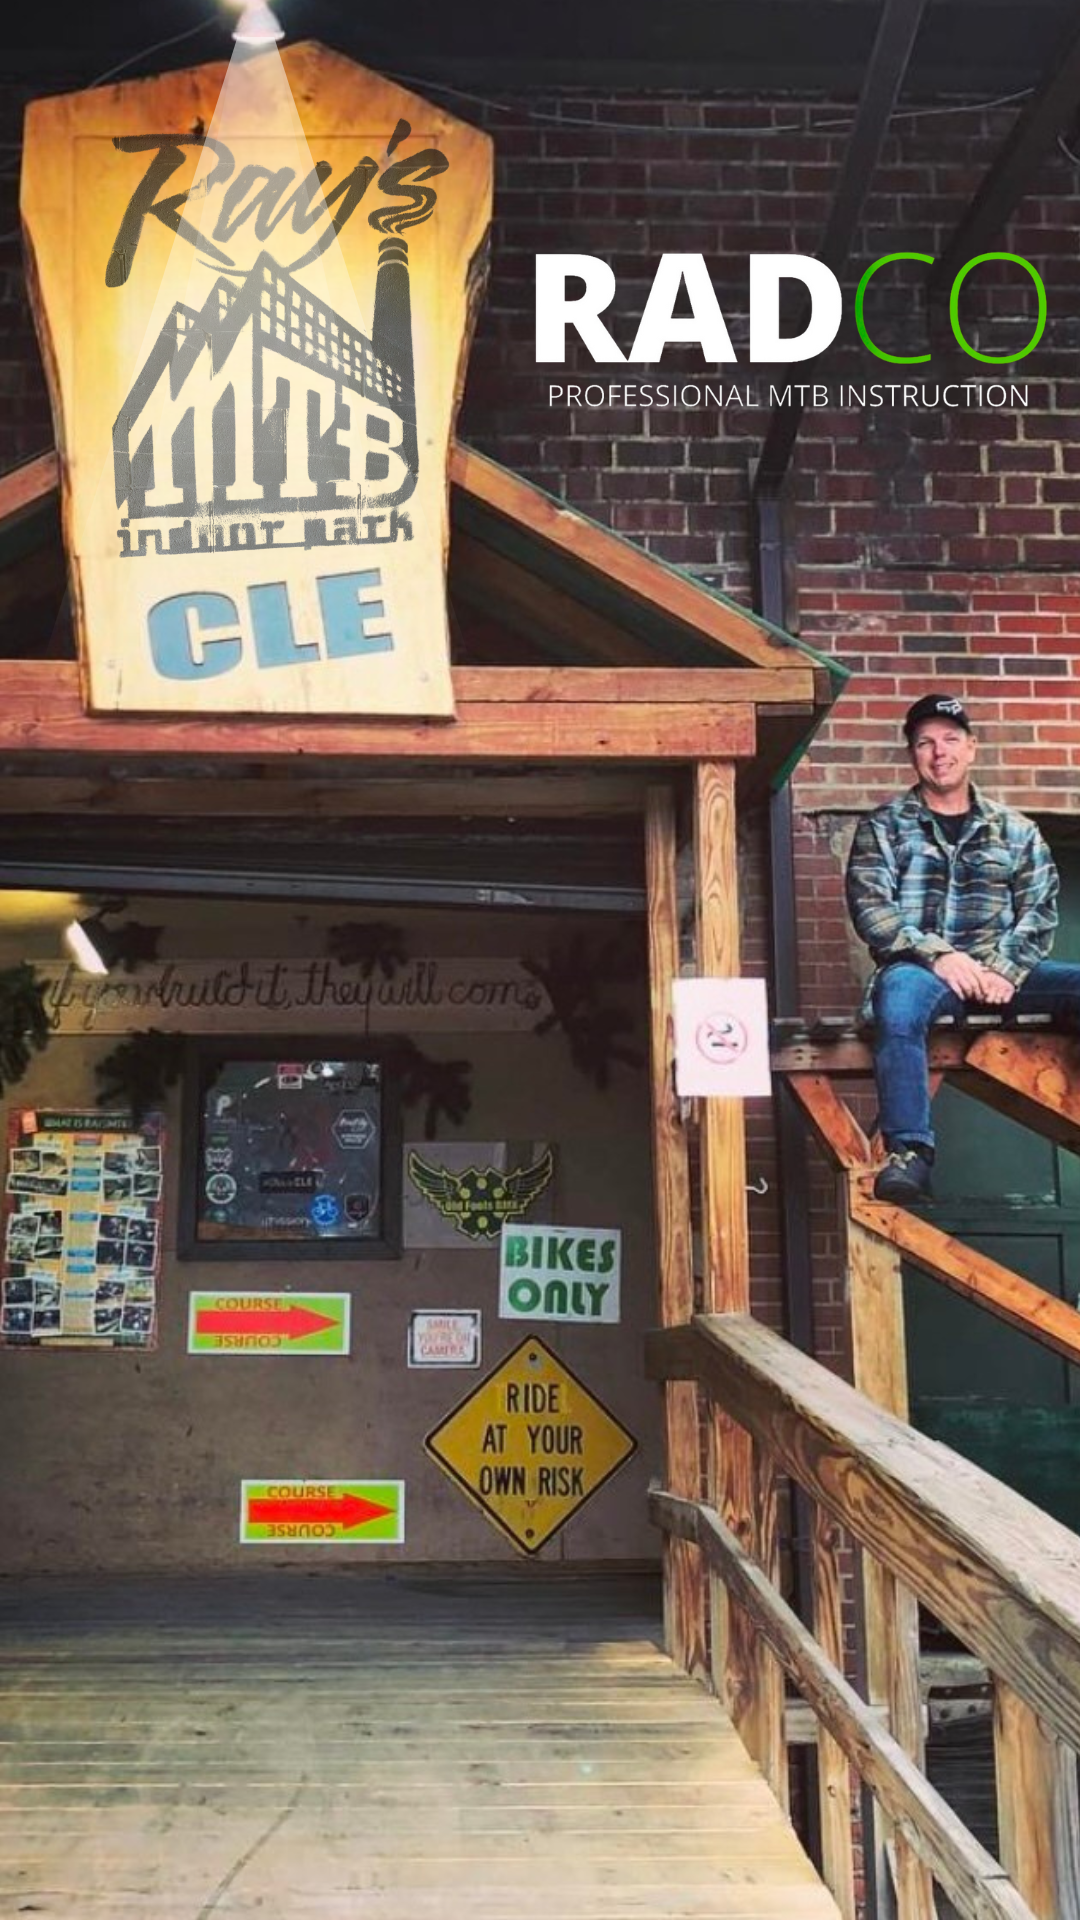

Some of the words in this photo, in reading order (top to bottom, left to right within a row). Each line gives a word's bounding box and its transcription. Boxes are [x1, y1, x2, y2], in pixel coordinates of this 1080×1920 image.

[105, 119, 449, 288] Ray's
[122, 312, 412, 508] MTB
[303, 508, 415, 550] park
[147, 567, 394, 681] CLE
[158, 962, 252, 1008] build
[295, 961, 371, 1018] they
[376, 961, 444, 1006] will
[504, 1235, 616, 1273] BIKES
[215, 1297, 283, 1310] COURSE
[508, 1278, 609, 1316] ONLY
[215, 1334, 282, 1348] COURSE
[506, 1383, 560, 1413] RIDE
[482, 1424, 508, 1455] AT
[527, 1425, 583, 1455] YOUR
[267, 1485, 335, 1498] COURSE
[479, 1466, 525, 1496] OWN
[538, 1467, 584, 1496] RISK
[267, 1524, 335, 1538] COURSE
